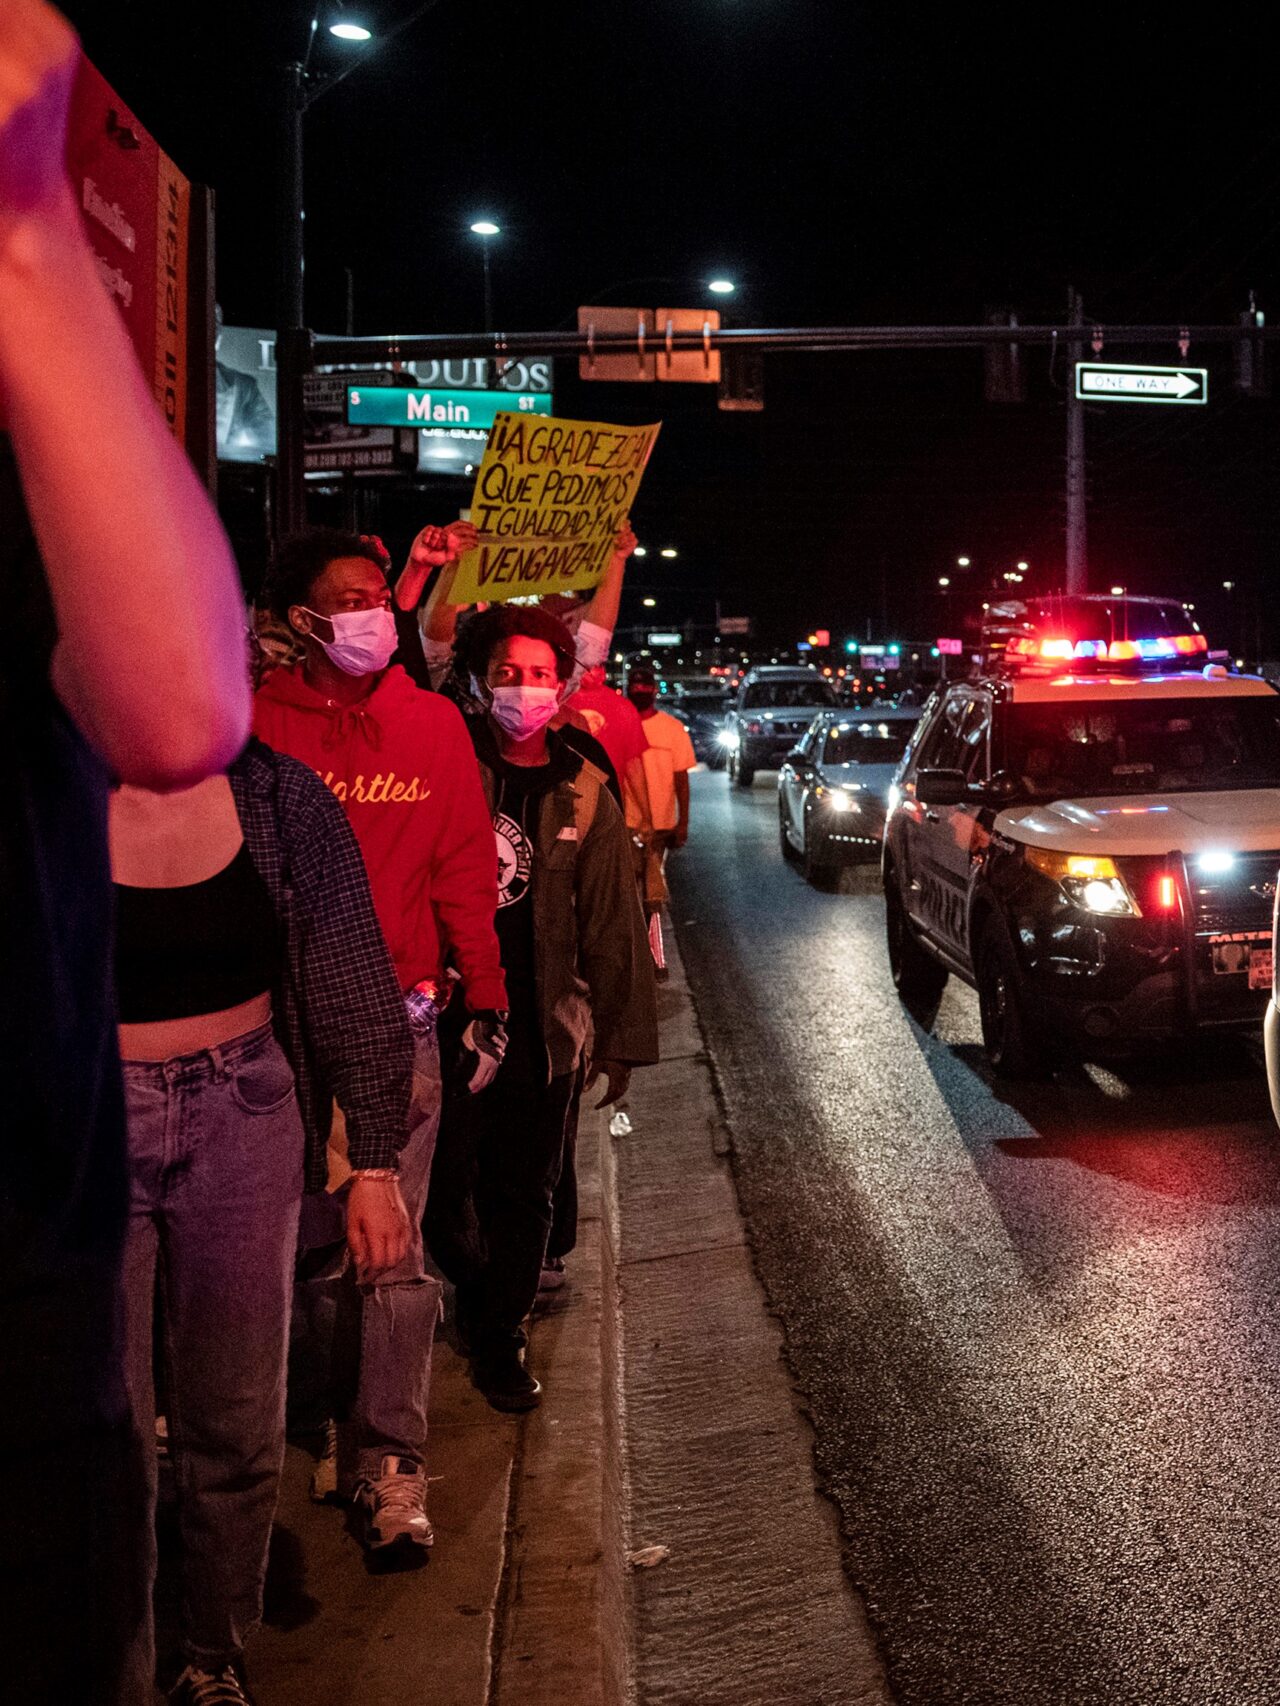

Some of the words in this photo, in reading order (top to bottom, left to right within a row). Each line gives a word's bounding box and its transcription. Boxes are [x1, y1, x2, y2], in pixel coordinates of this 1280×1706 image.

[1095, 375, 1125, 388] ONE
[1136, 379, 1169, 389] WAY
[351, 391, 361, 405] S
[407, 393, 469, 423] Main
[519, 396, 535, 410] ST
[539, 470, 634, 506] PEDIMOS
[1209, 930, 1273, 944] METR
